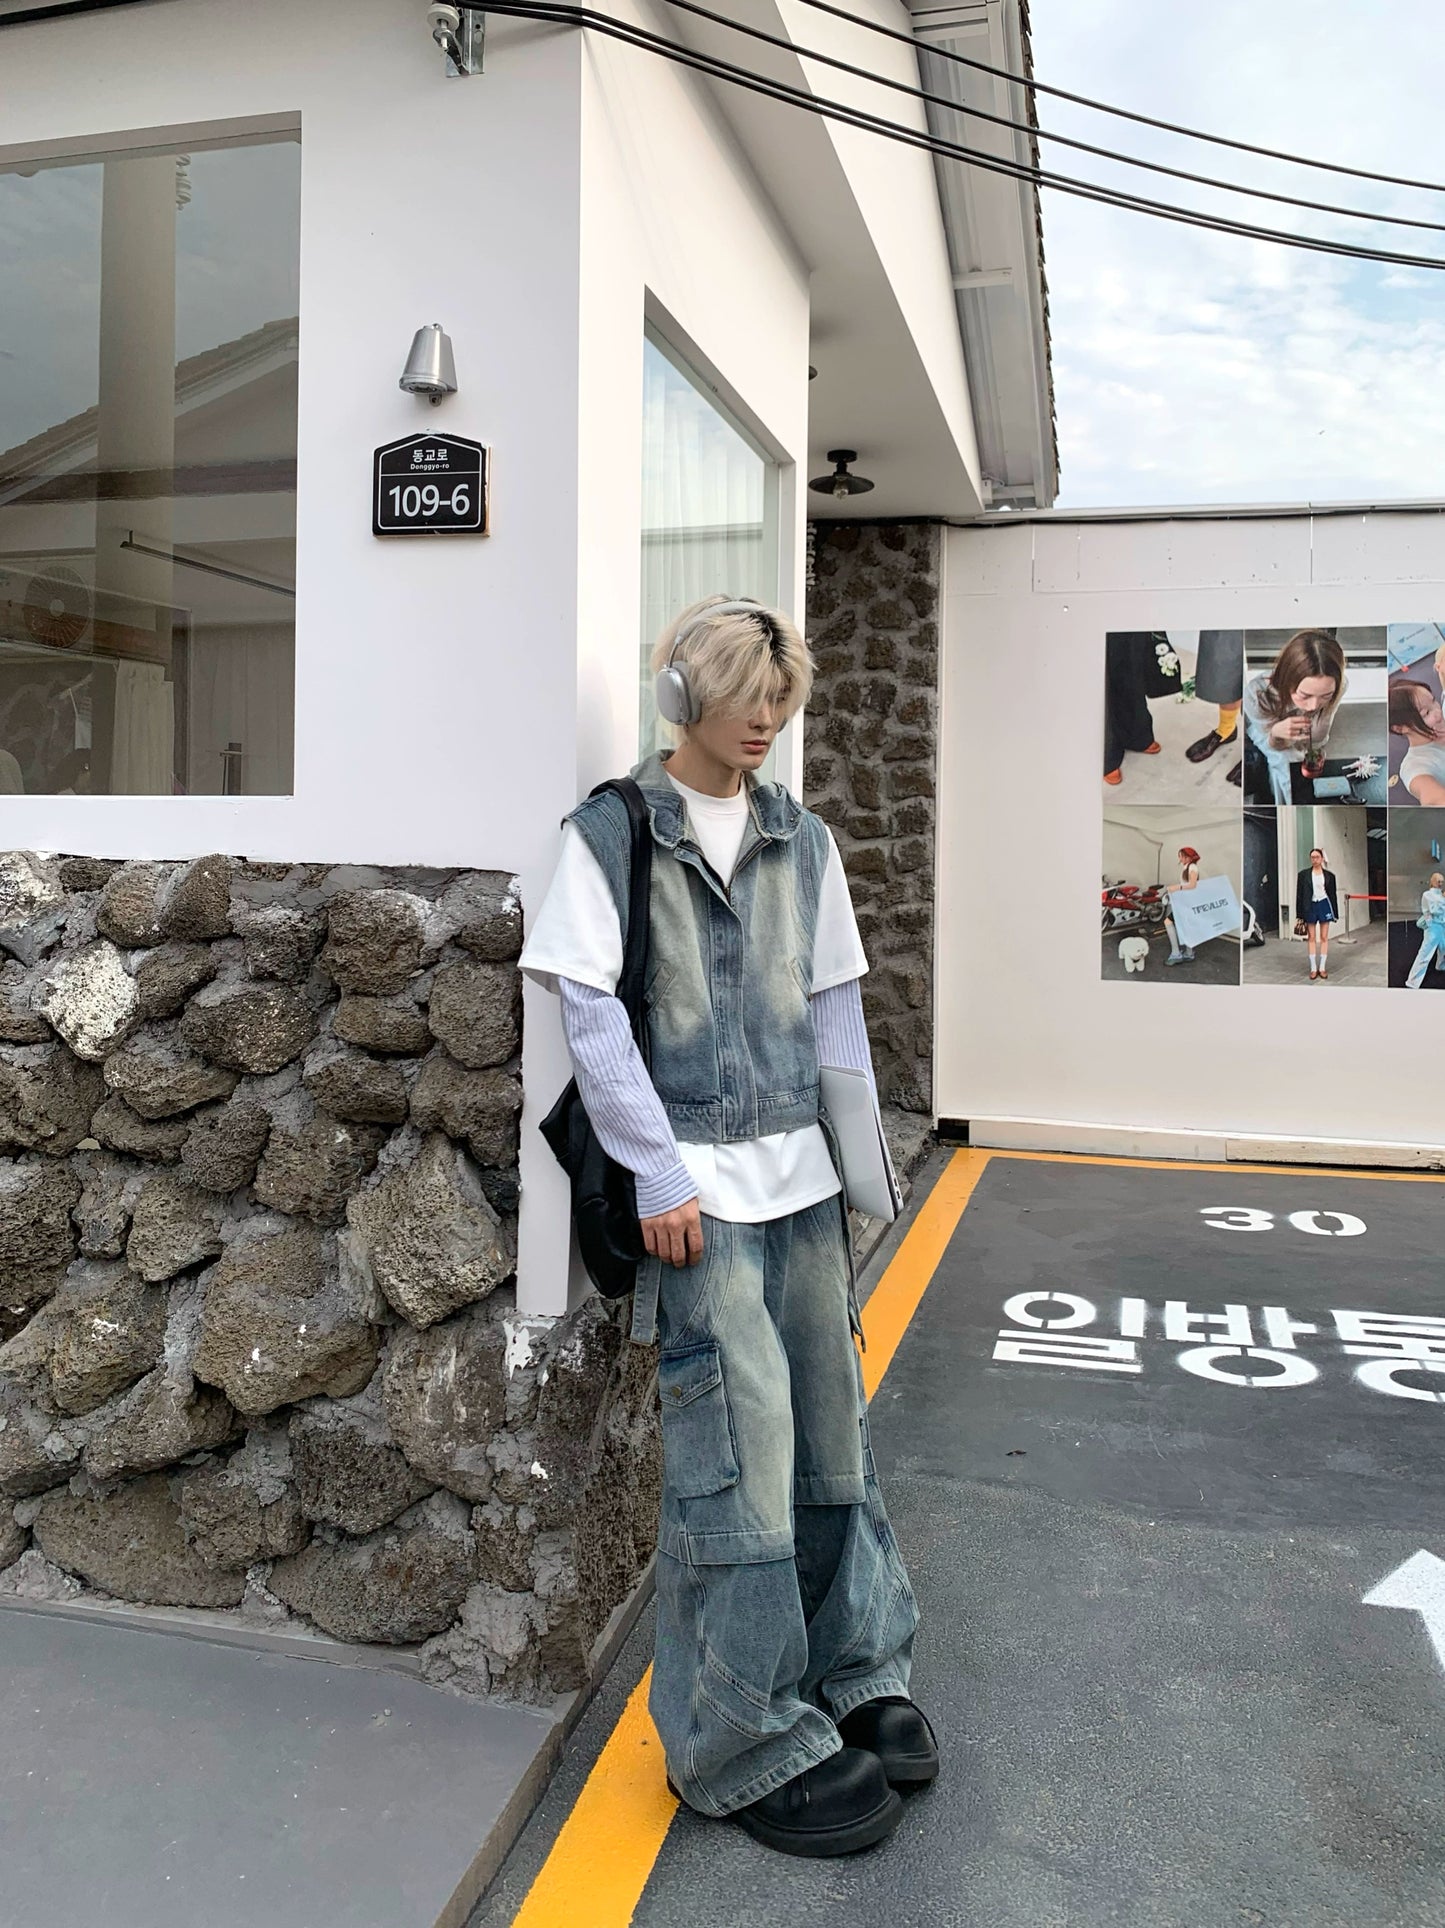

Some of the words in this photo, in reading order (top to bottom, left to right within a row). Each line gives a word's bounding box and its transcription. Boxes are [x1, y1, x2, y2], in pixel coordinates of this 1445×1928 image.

[410, 463, 450, 471] Donggyo-ro
[412, 448, 448, 463] 동교로
[389, 483, 470, 517] 109-6
[1200, 1206, 1368, 1237] 30
